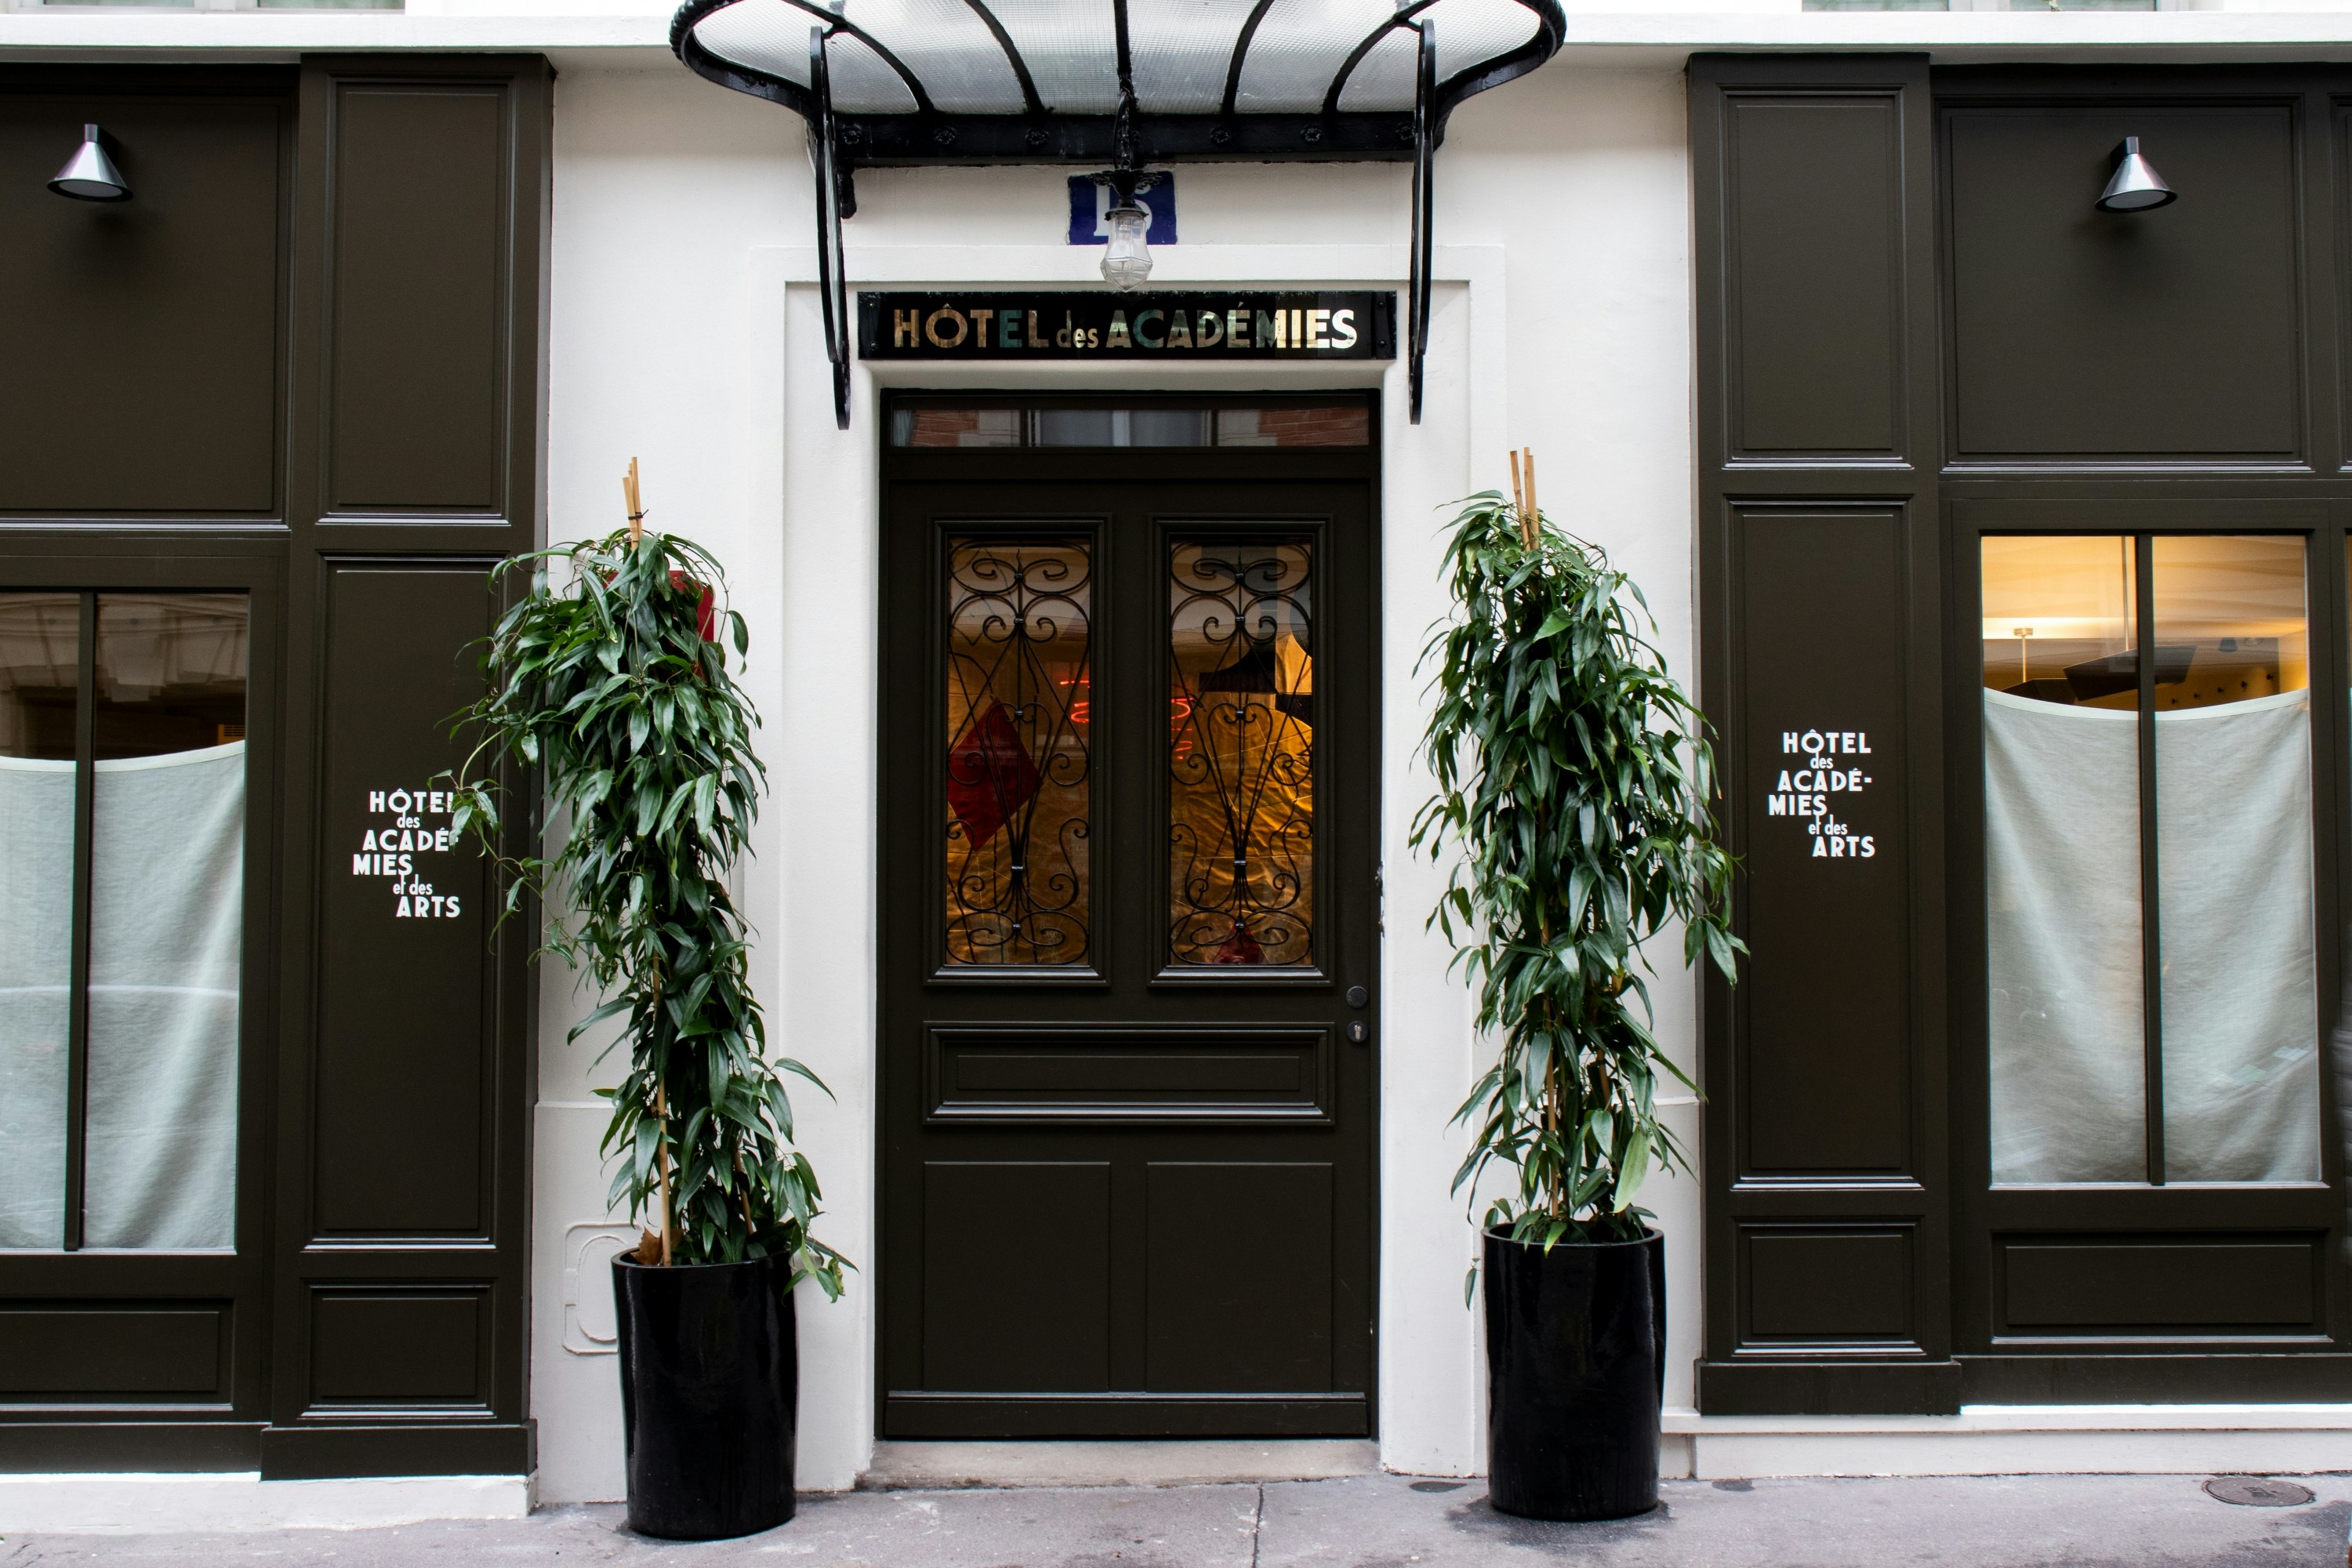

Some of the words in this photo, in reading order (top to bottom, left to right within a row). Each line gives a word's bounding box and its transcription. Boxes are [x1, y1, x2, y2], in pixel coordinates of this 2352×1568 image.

[1093, 180, 1152, 237] 1
[894, 303, 1050, 348] HÔTEL
[1056, 310, 1099, 348] des
[1105, 301, 1358, 349] ACADÉMIES
[1782, 728, 1872, 753] HÔTEL
[1809, 752, 1834, 769] des
[1777, 768, 1872, 792] ACADÉ-
[1768, 794, 1828, 816] MIES
[397, 811, 421, 829] des
[1808, 815, 1822, 835] et
[1824, 814, 1849, 836] des
[1812, 836, 1875, 858] ARTS
[353, 854, 413, 876] MIES
[393, 876, 406, 895] et
[408, 874, 434, 895] des
[396, 895, 461, 918] ARTS
